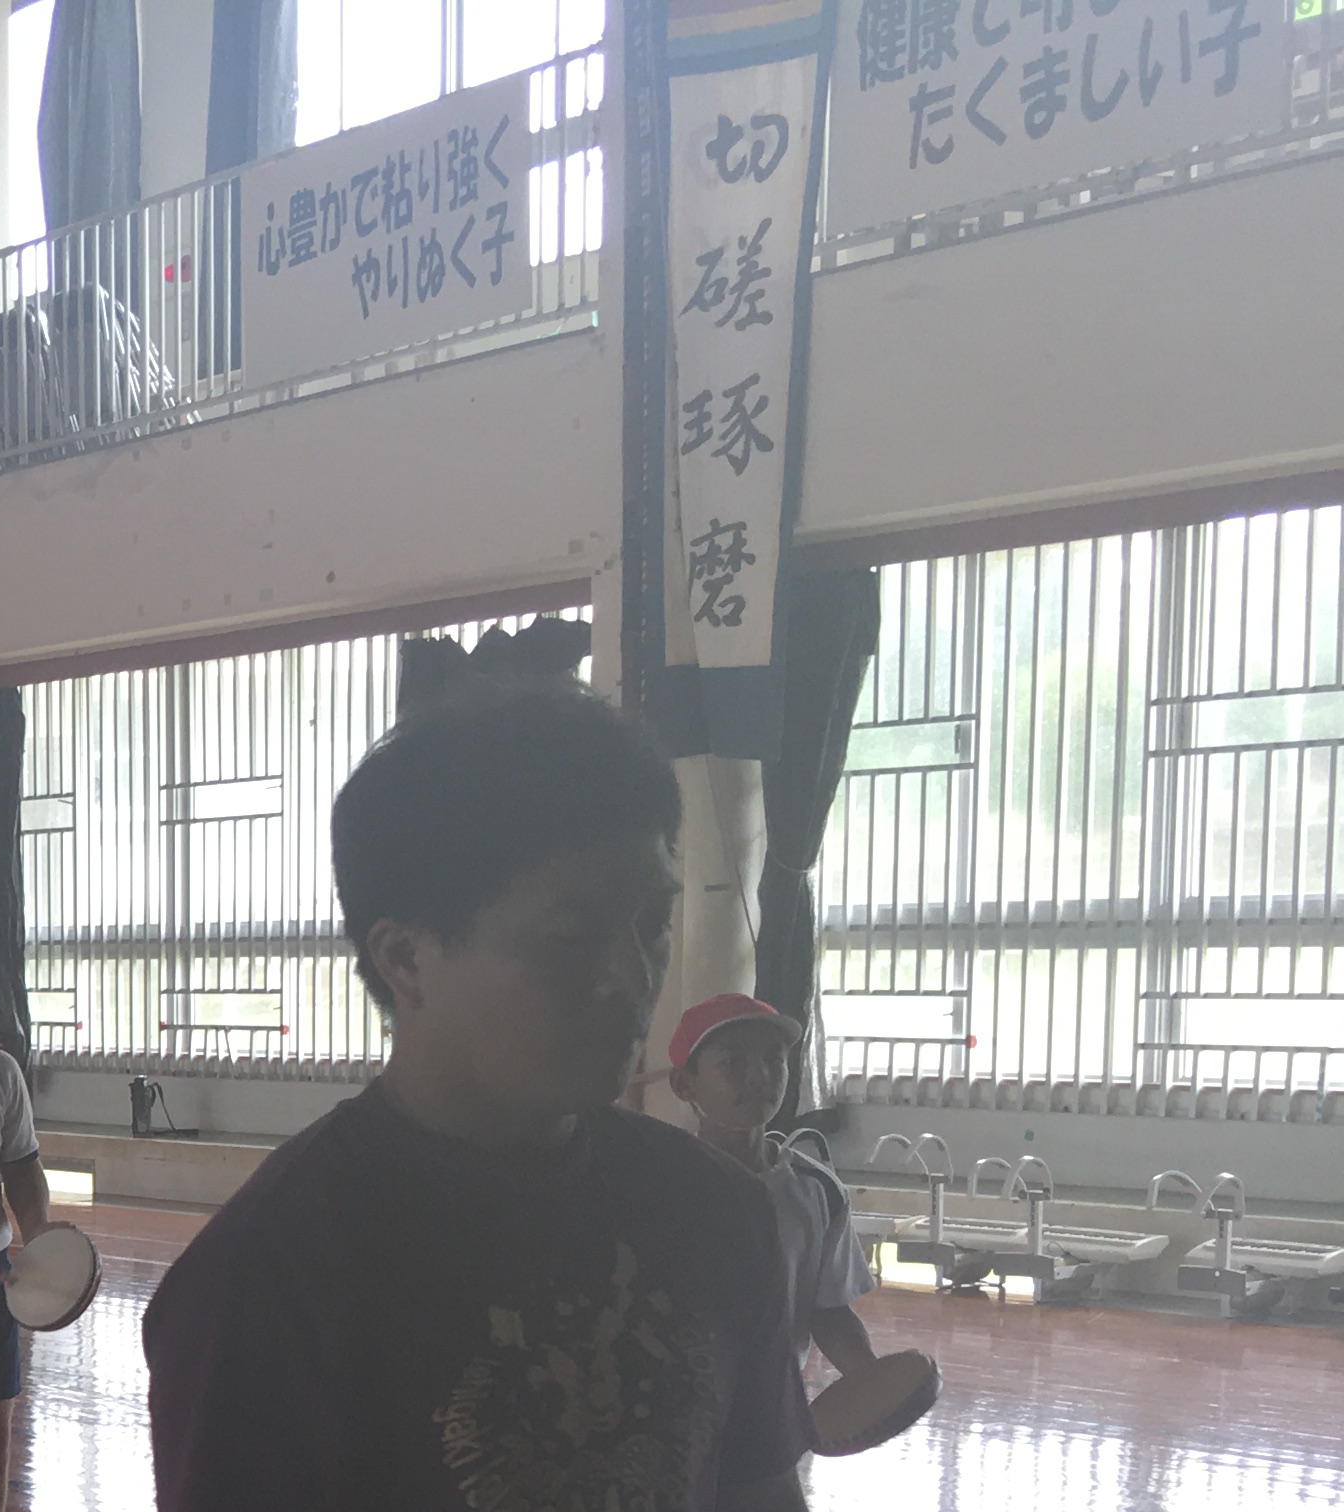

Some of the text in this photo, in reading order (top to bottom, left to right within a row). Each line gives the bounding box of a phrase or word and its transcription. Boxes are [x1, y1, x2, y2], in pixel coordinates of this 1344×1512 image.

[258, 114, 510, 276] 心豊かで粘り強く
[352, 201, 515, 320] やりぬく子
